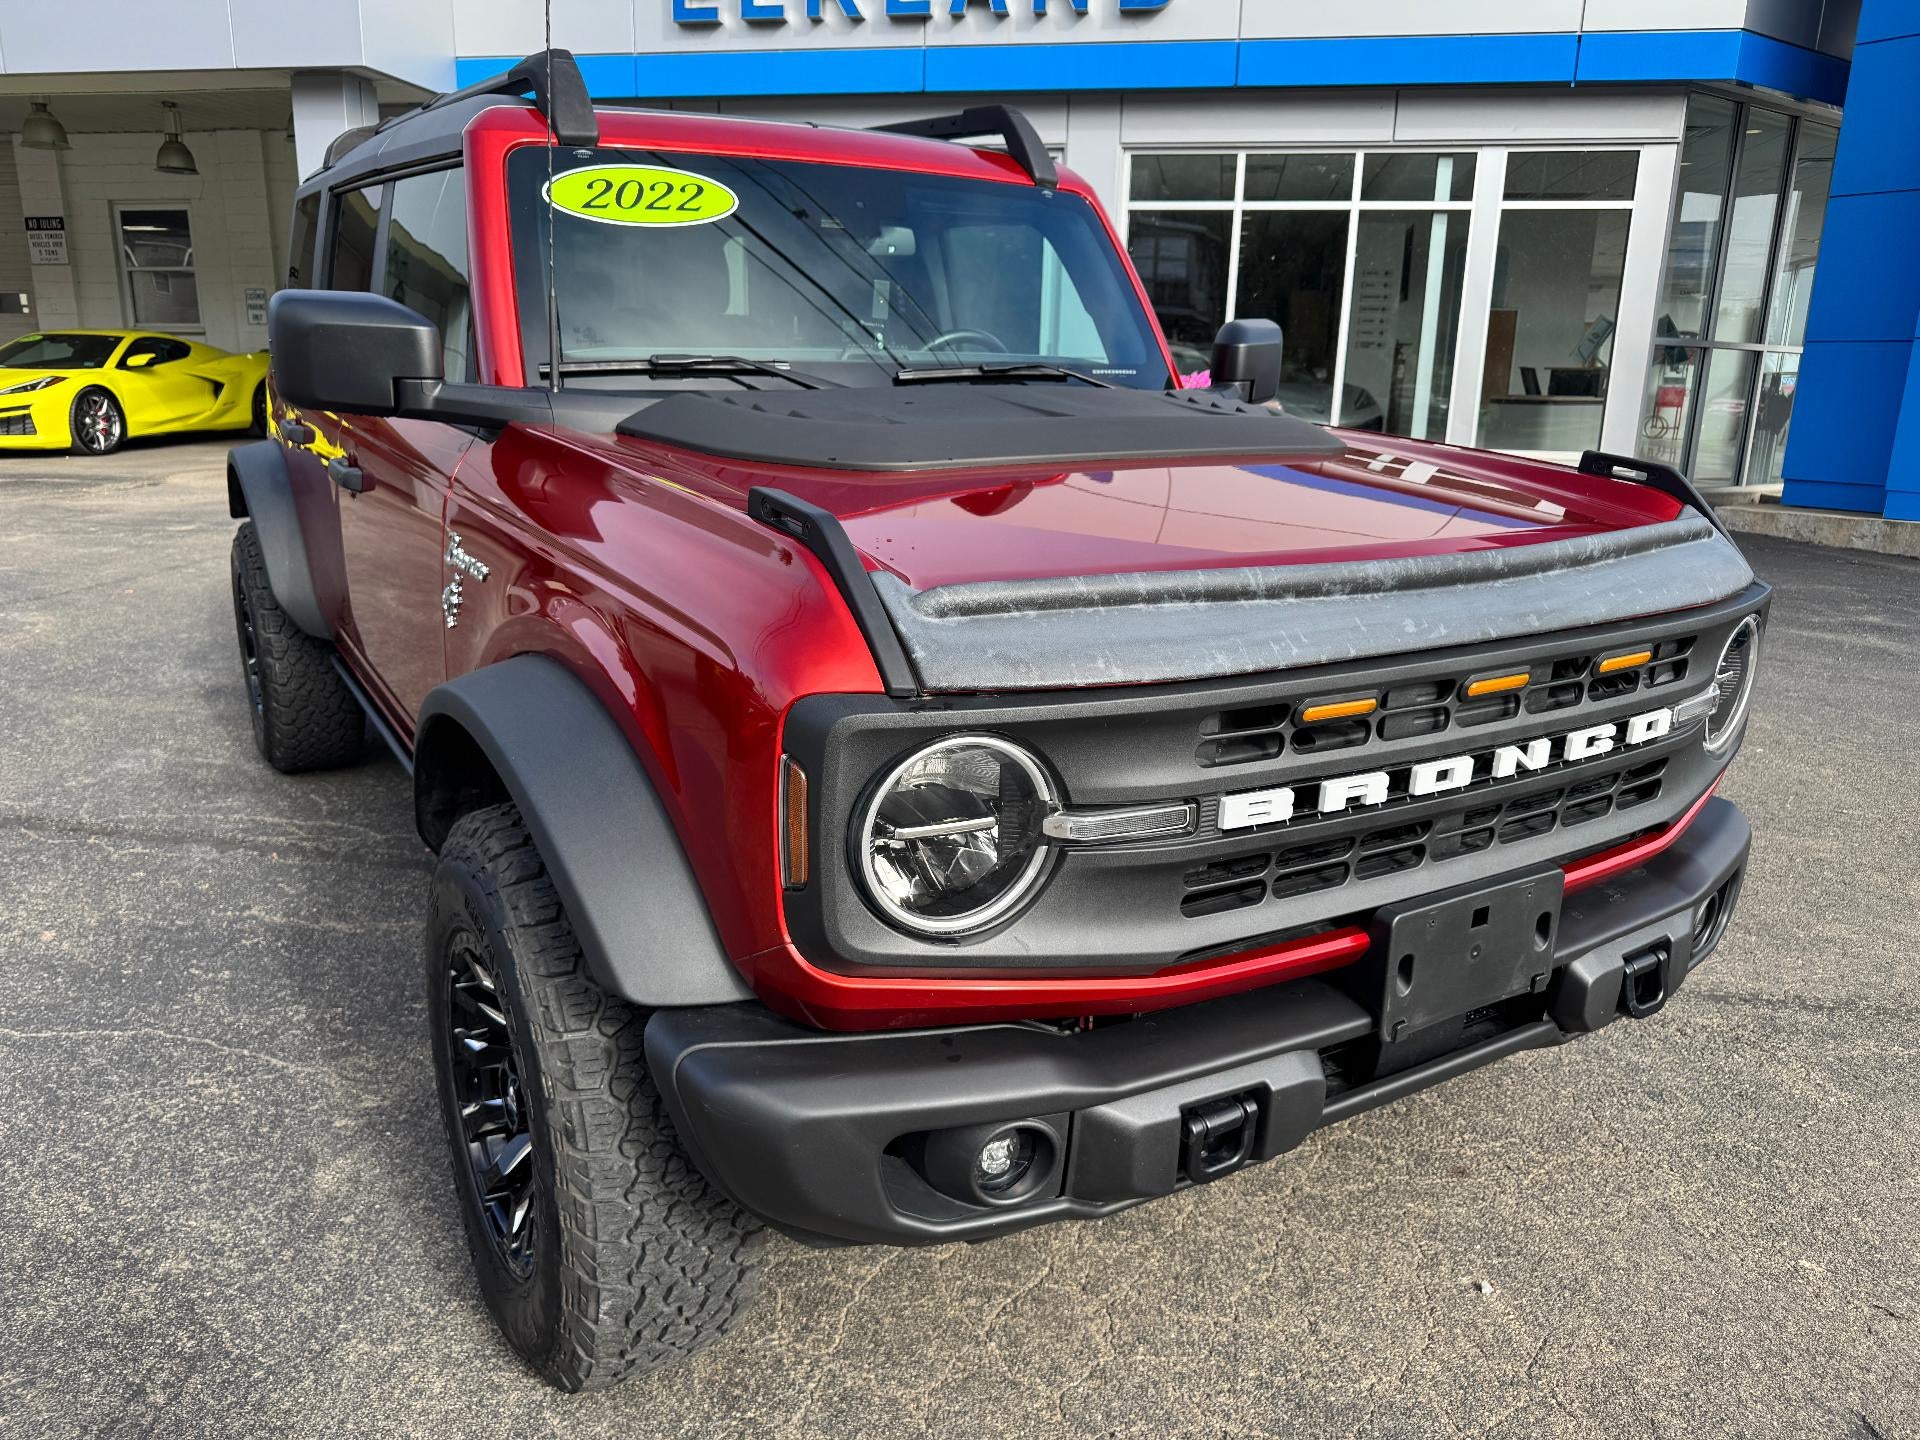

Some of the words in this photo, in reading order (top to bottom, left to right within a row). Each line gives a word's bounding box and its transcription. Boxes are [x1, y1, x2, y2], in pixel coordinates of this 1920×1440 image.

[581, 178, 704, 211] 2022
[28, 218, 37, 229] NO
[40, 218, 61, 229] IDLING
[1217, 708, 1672, 830] BRONCO
